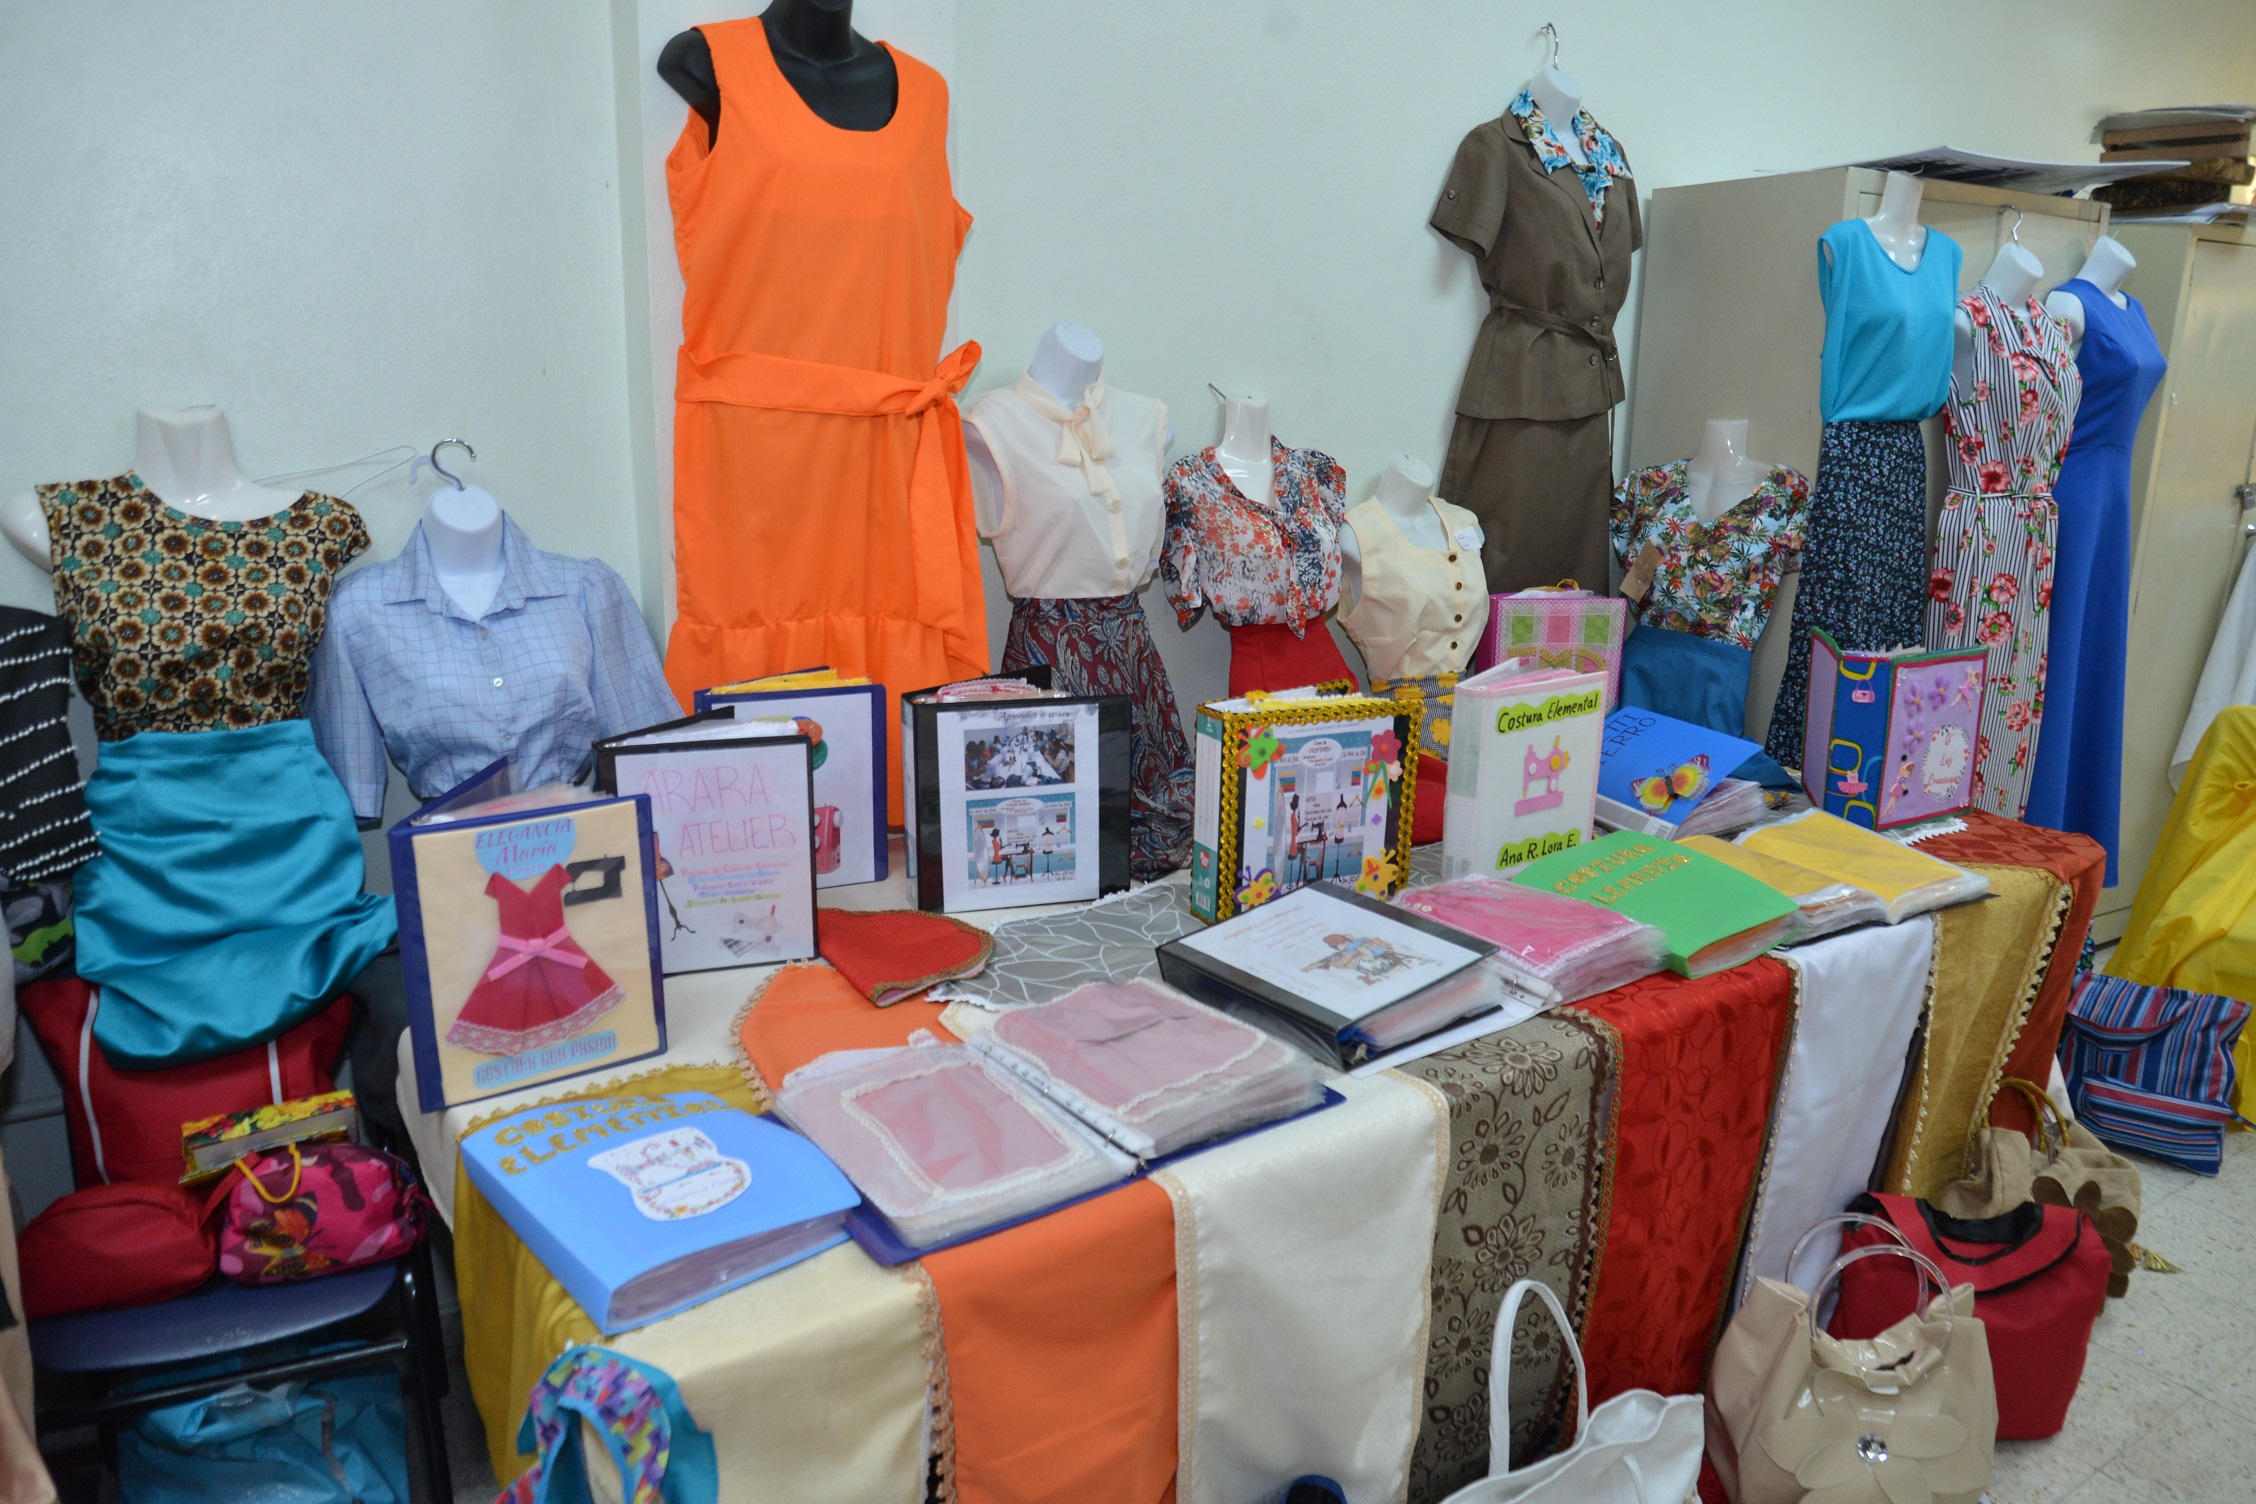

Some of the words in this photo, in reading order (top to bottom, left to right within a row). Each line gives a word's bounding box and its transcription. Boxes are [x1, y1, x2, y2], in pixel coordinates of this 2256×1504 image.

[1000, 709, 1037, 722] Aprender
[1048, 710, 1071, 719] coser
[1498, 712, 1543, 733] Costura
[1547, 693, 1598, 719] Elemental
[643, 764, 770, 815] ARARA
[475, 819, 571, 850] ELEGANCIA
[680, 815, 796, 858] ATELIER
[1500, 848, 1523, 867] Ana
[1527, 842, 1538, 859] R.
[1541, 840, 1563, 856] Lora
[1566, 833, 1577, 848] E.
[1554, 844, 1658, 894] COSTURA
[494, 1096, 668, 1147] COSTURA
[498, 1100, 737, 1176] ELEMENTAL
